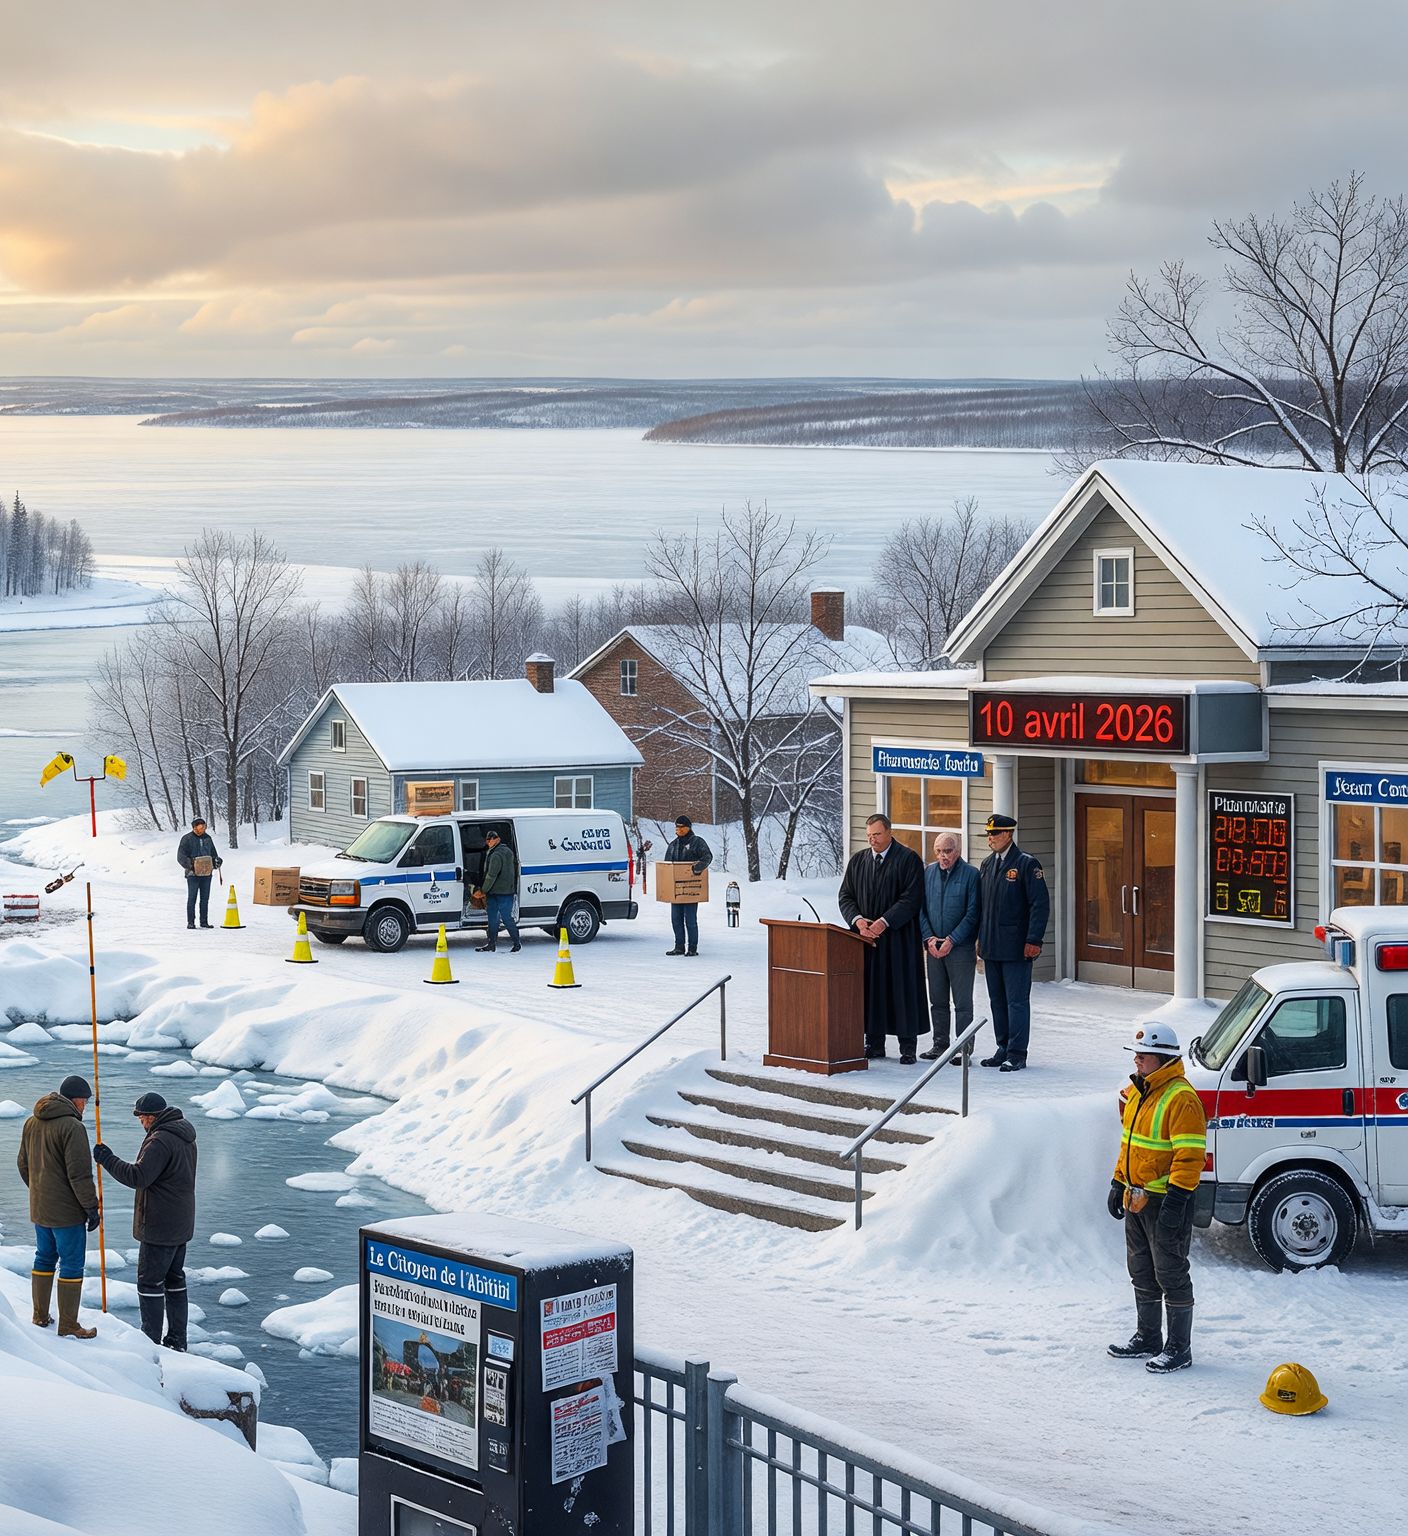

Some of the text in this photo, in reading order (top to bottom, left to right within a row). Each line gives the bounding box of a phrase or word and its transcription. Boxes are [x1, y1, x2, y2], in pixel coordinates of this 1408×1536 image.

[980, 700, 1174, 743] 10 avril 2026
[369, 1246, 384, 1267] Le
[387, 1251, 437, 1280] Citoyen
[440, 1266, 456, 1286] de
